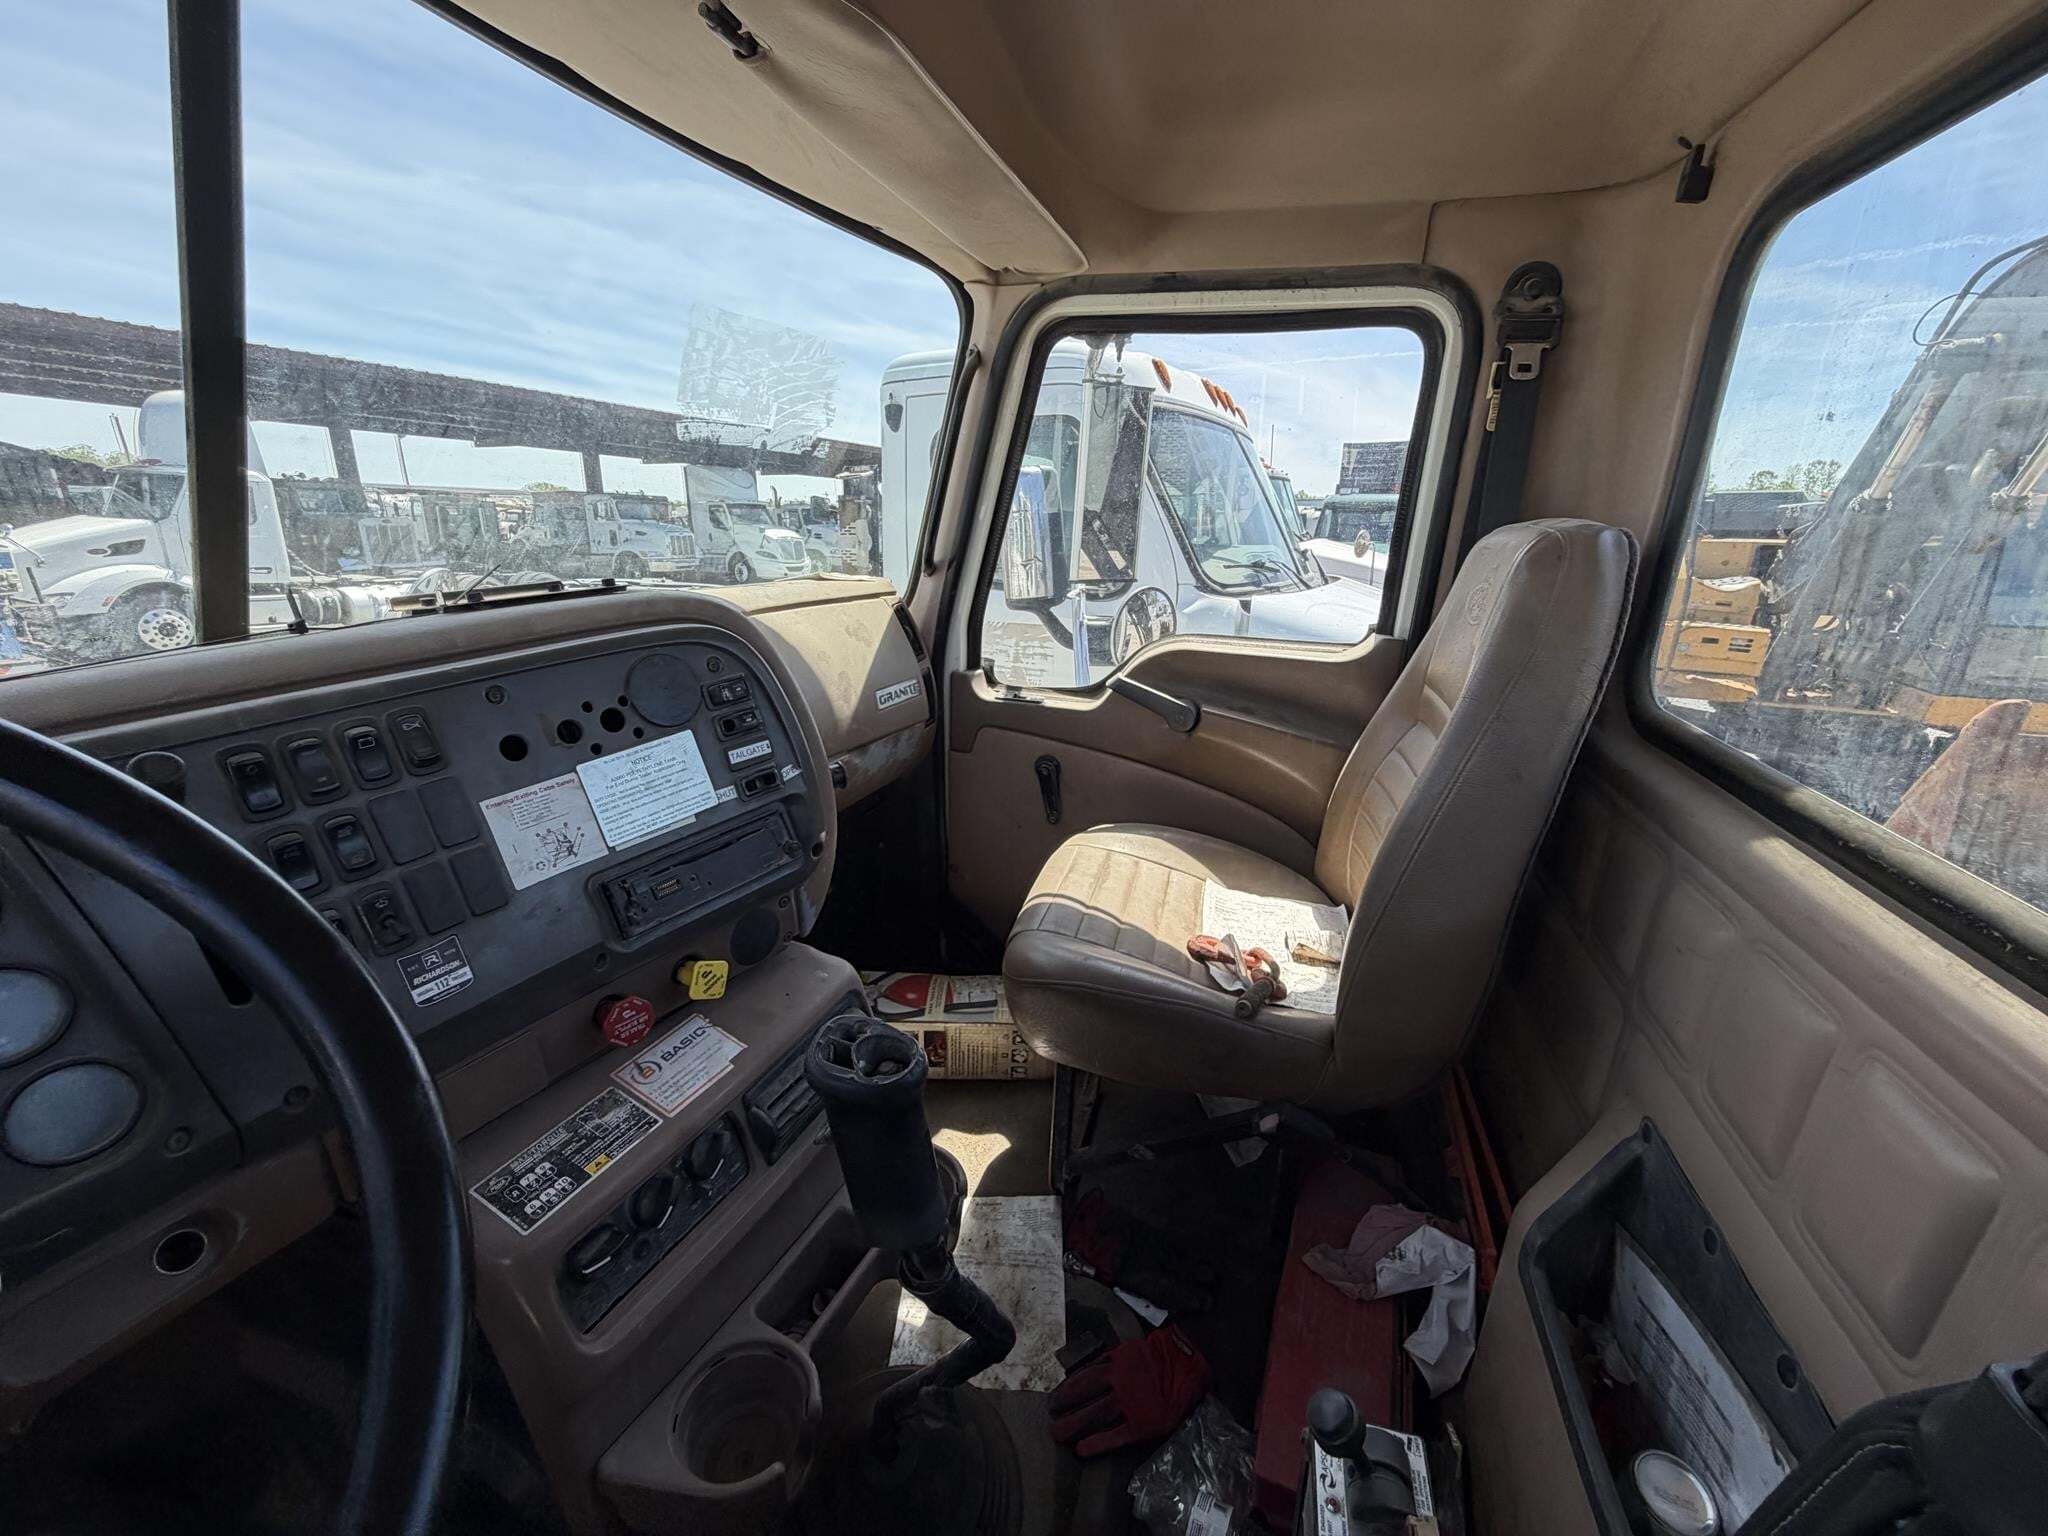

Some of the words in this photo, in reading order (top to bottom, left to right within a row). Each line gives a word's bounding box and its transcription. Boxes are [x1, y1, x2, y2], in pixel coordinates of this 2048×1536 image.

[879, 683, 920, 706] GRANITE
[730, 743, 767, 760] TAILGATE
[412, 959, 461, 985] RICHARDSON
[434, 977, 450, 991] 112
[660, 1025, 707, 1062] BASIC
